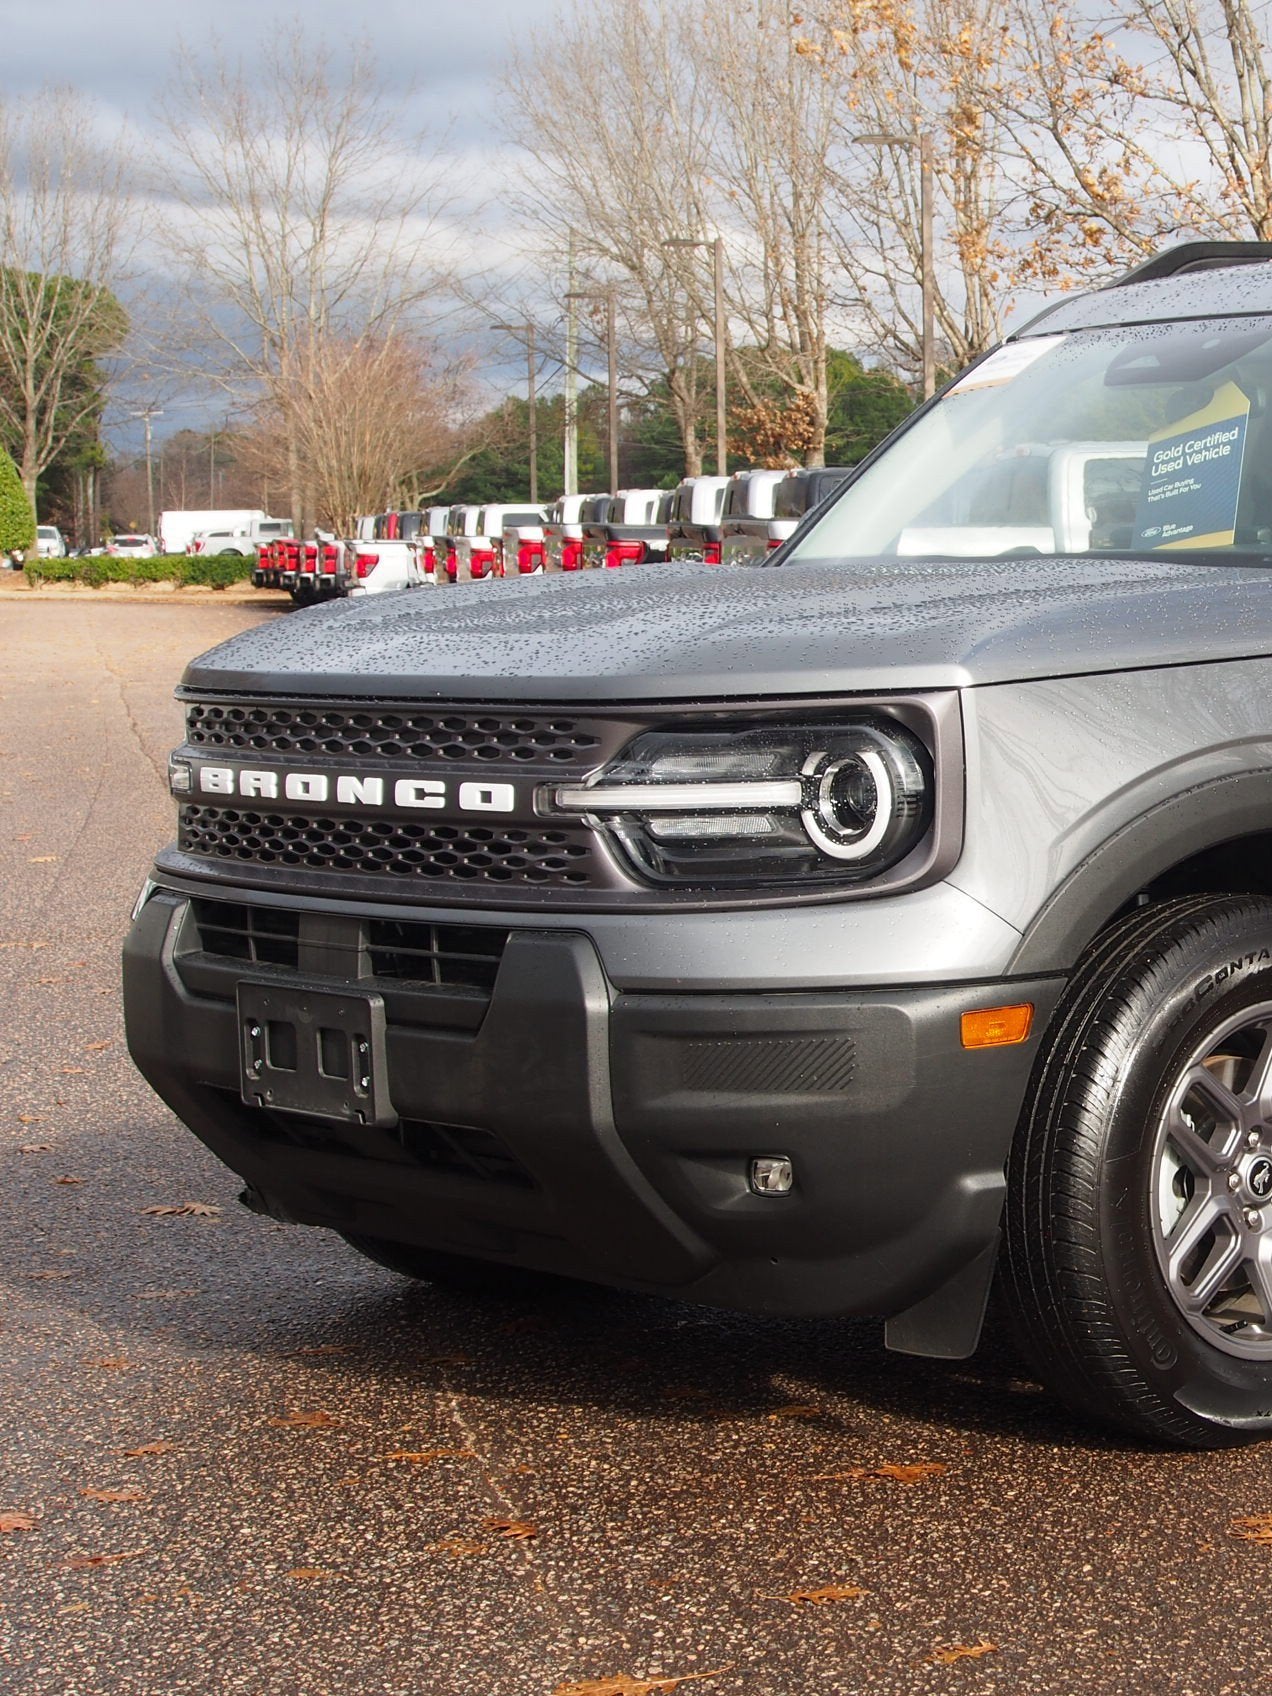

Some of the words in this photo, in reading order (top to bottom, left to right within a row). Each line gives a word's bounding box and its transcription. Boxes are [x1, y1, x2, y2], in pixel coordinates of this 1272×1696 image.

[1151, 456, 1184, 477] Used
[1186, 444, 1231, 466] Vehicle
[1153, 444, 1183, 463] Gold
[1185, 426, 1239, 453] Certified
[1148, 486, 1163, 496] Used
[1174, 478, 1195, 488] Buying
[199, 765, 515, 813] BRONCO
